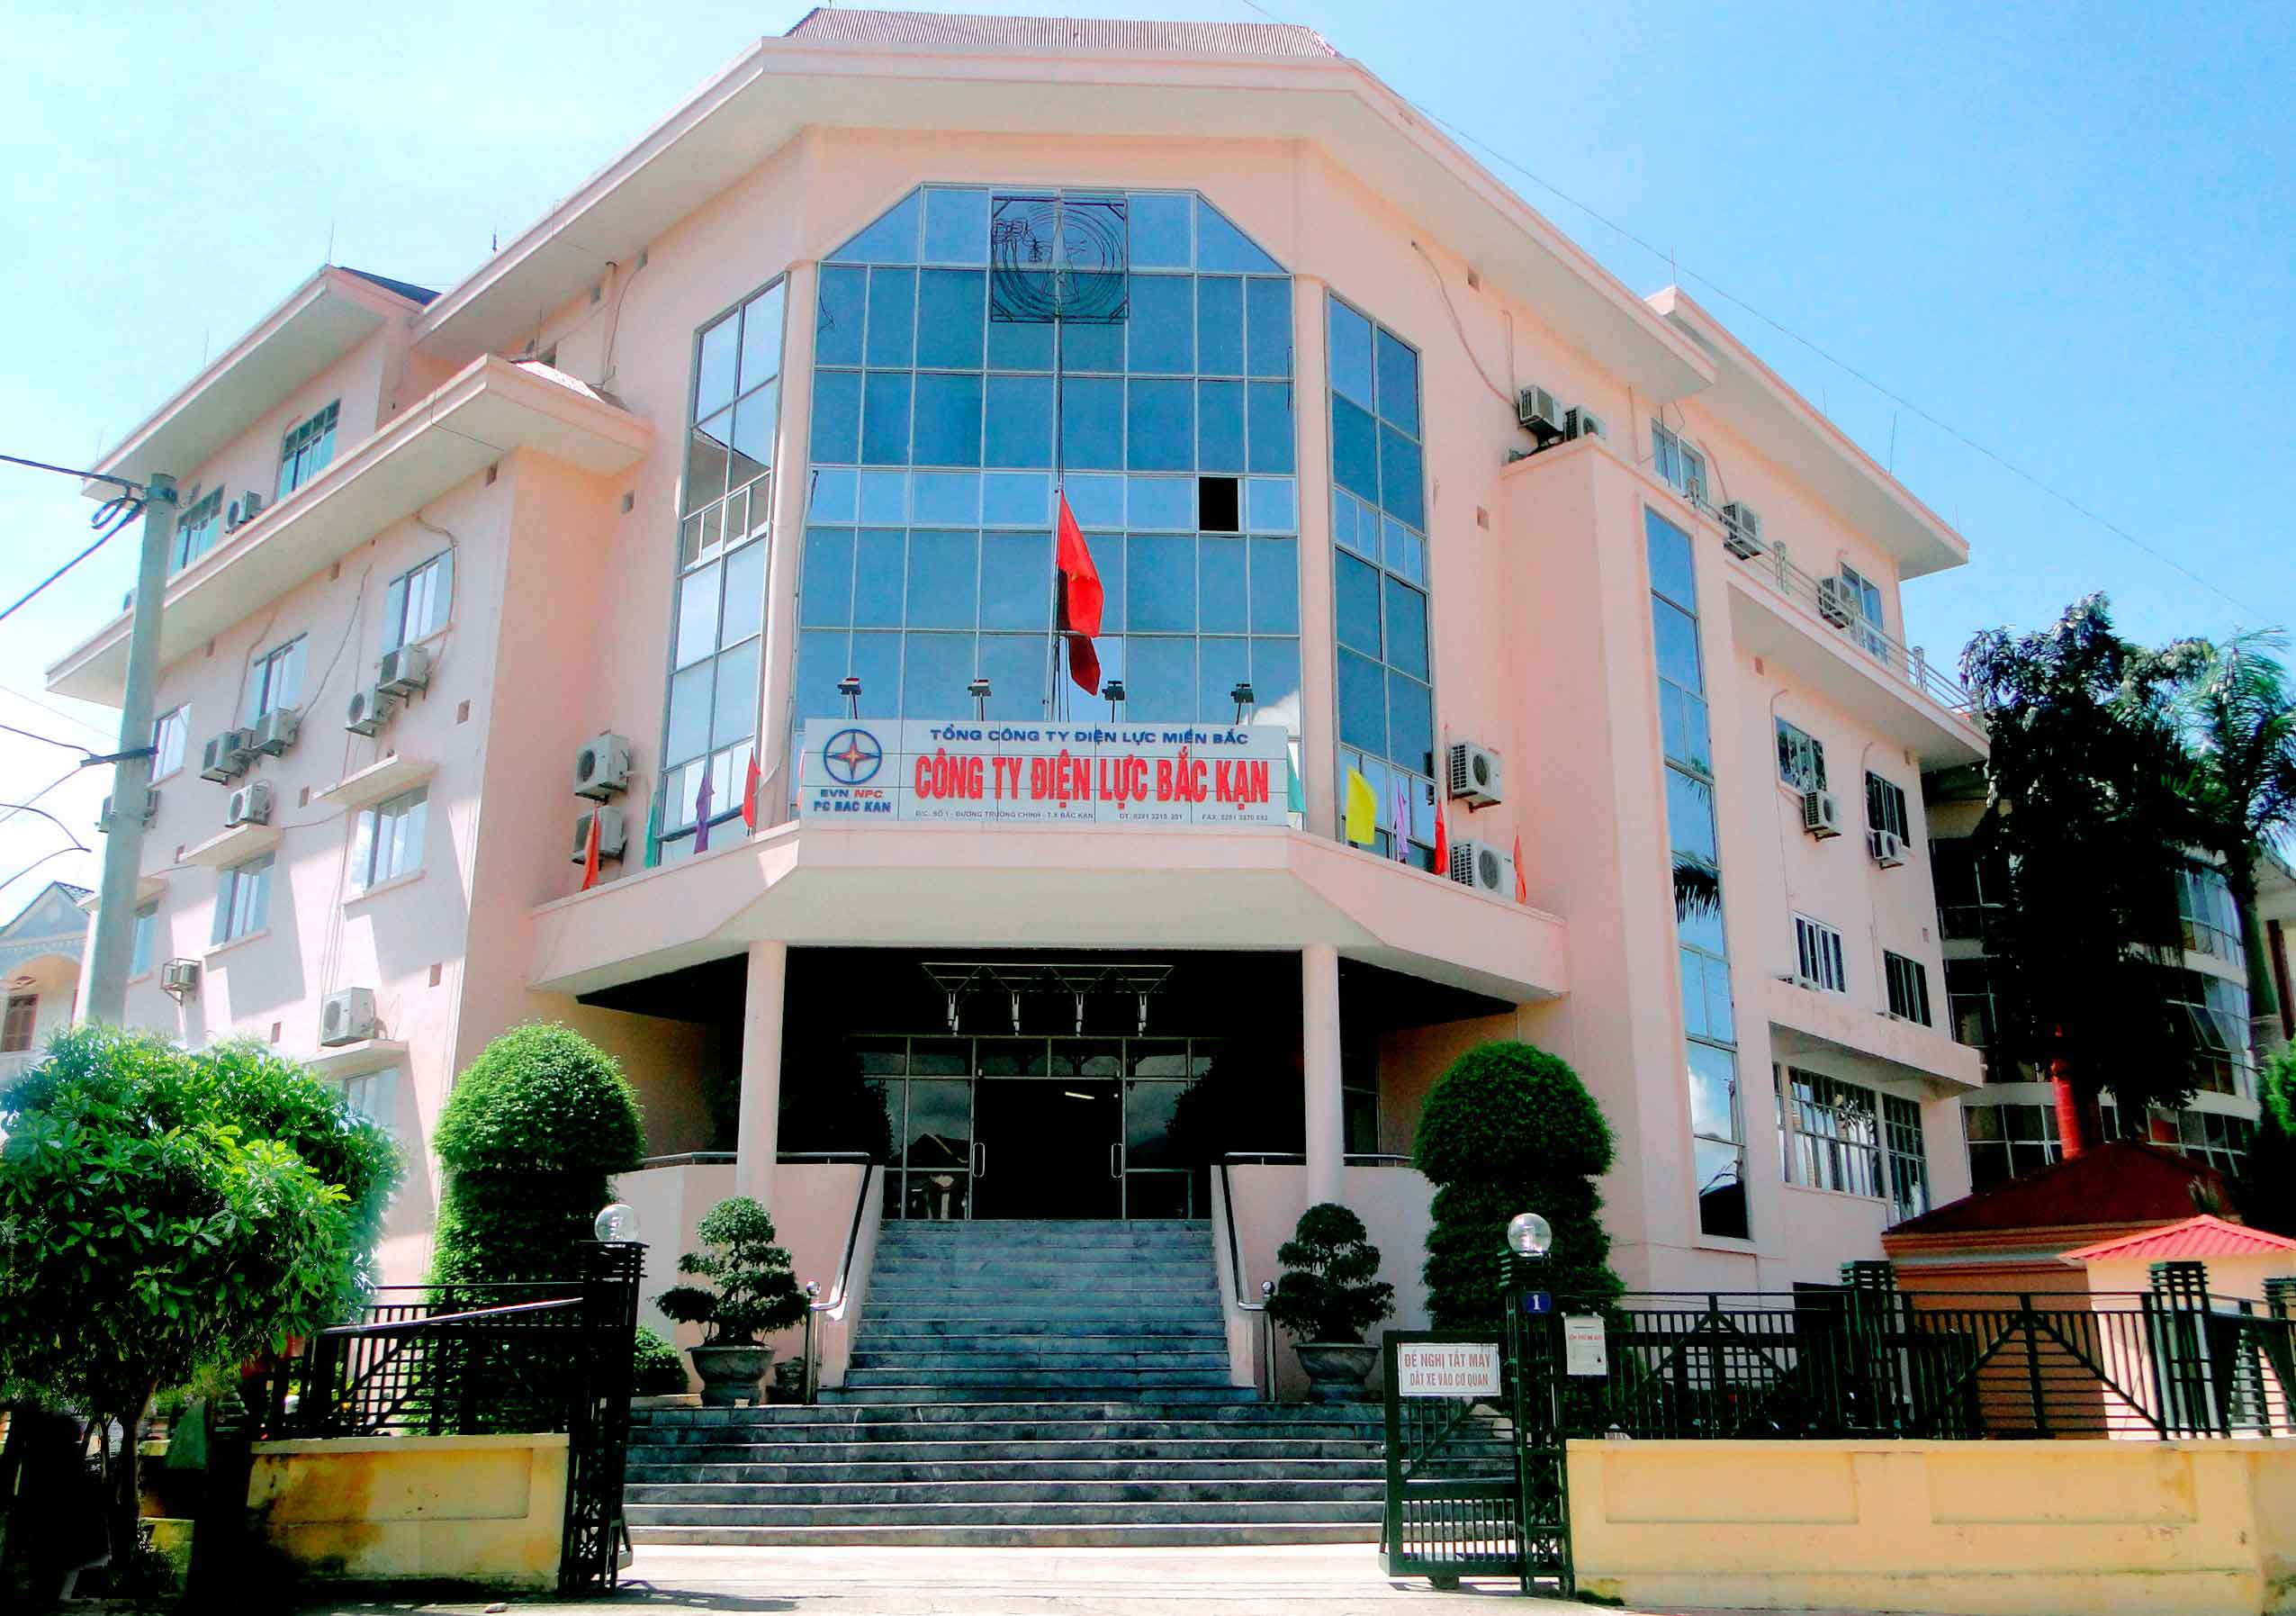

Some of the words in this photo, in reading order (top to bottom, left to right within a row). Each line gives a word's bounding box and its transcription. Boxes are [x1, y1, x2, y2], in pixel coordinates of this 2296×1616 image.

[930, 724, 982, 741] TỔNG
[988, 727, 1040, 742] CÔNG
[1046, 731, 1069, 742] TY
[1074, 728, 1117, 745] ĐIỆN
[1122, 730, 1157, 746] LỰC
[1213, 727, 1249, 745] BẮC
[914, 747, 984, 799] CÔNG
[992, 757, 1022, 799] TY
[1031, 749, 1091, 808] ĐIỆN
[1099, 754, 1148, 809] LỰC
[1157, 745, 1208, 802] BẮC
[1216, 760, 1269, 810] KẠN
[820, 789, 850, 798] EVN
[854, 789, 884, 799] NPC
[814, 800, 831, 811] PC
[1533, 1294, 1541, 1310] 1
[1420, 1353, 1445, 1368] NGHỊ
[1469, 1348, 1490, 1368] MÁY
[1426, 1373, 1437, 1386] XE
[1438, 1369, 1454, 1386] VÀO
[1455, 1372, 1466, 1386] CƠ
[1467, 1372, 1489, 1387] QUAN
